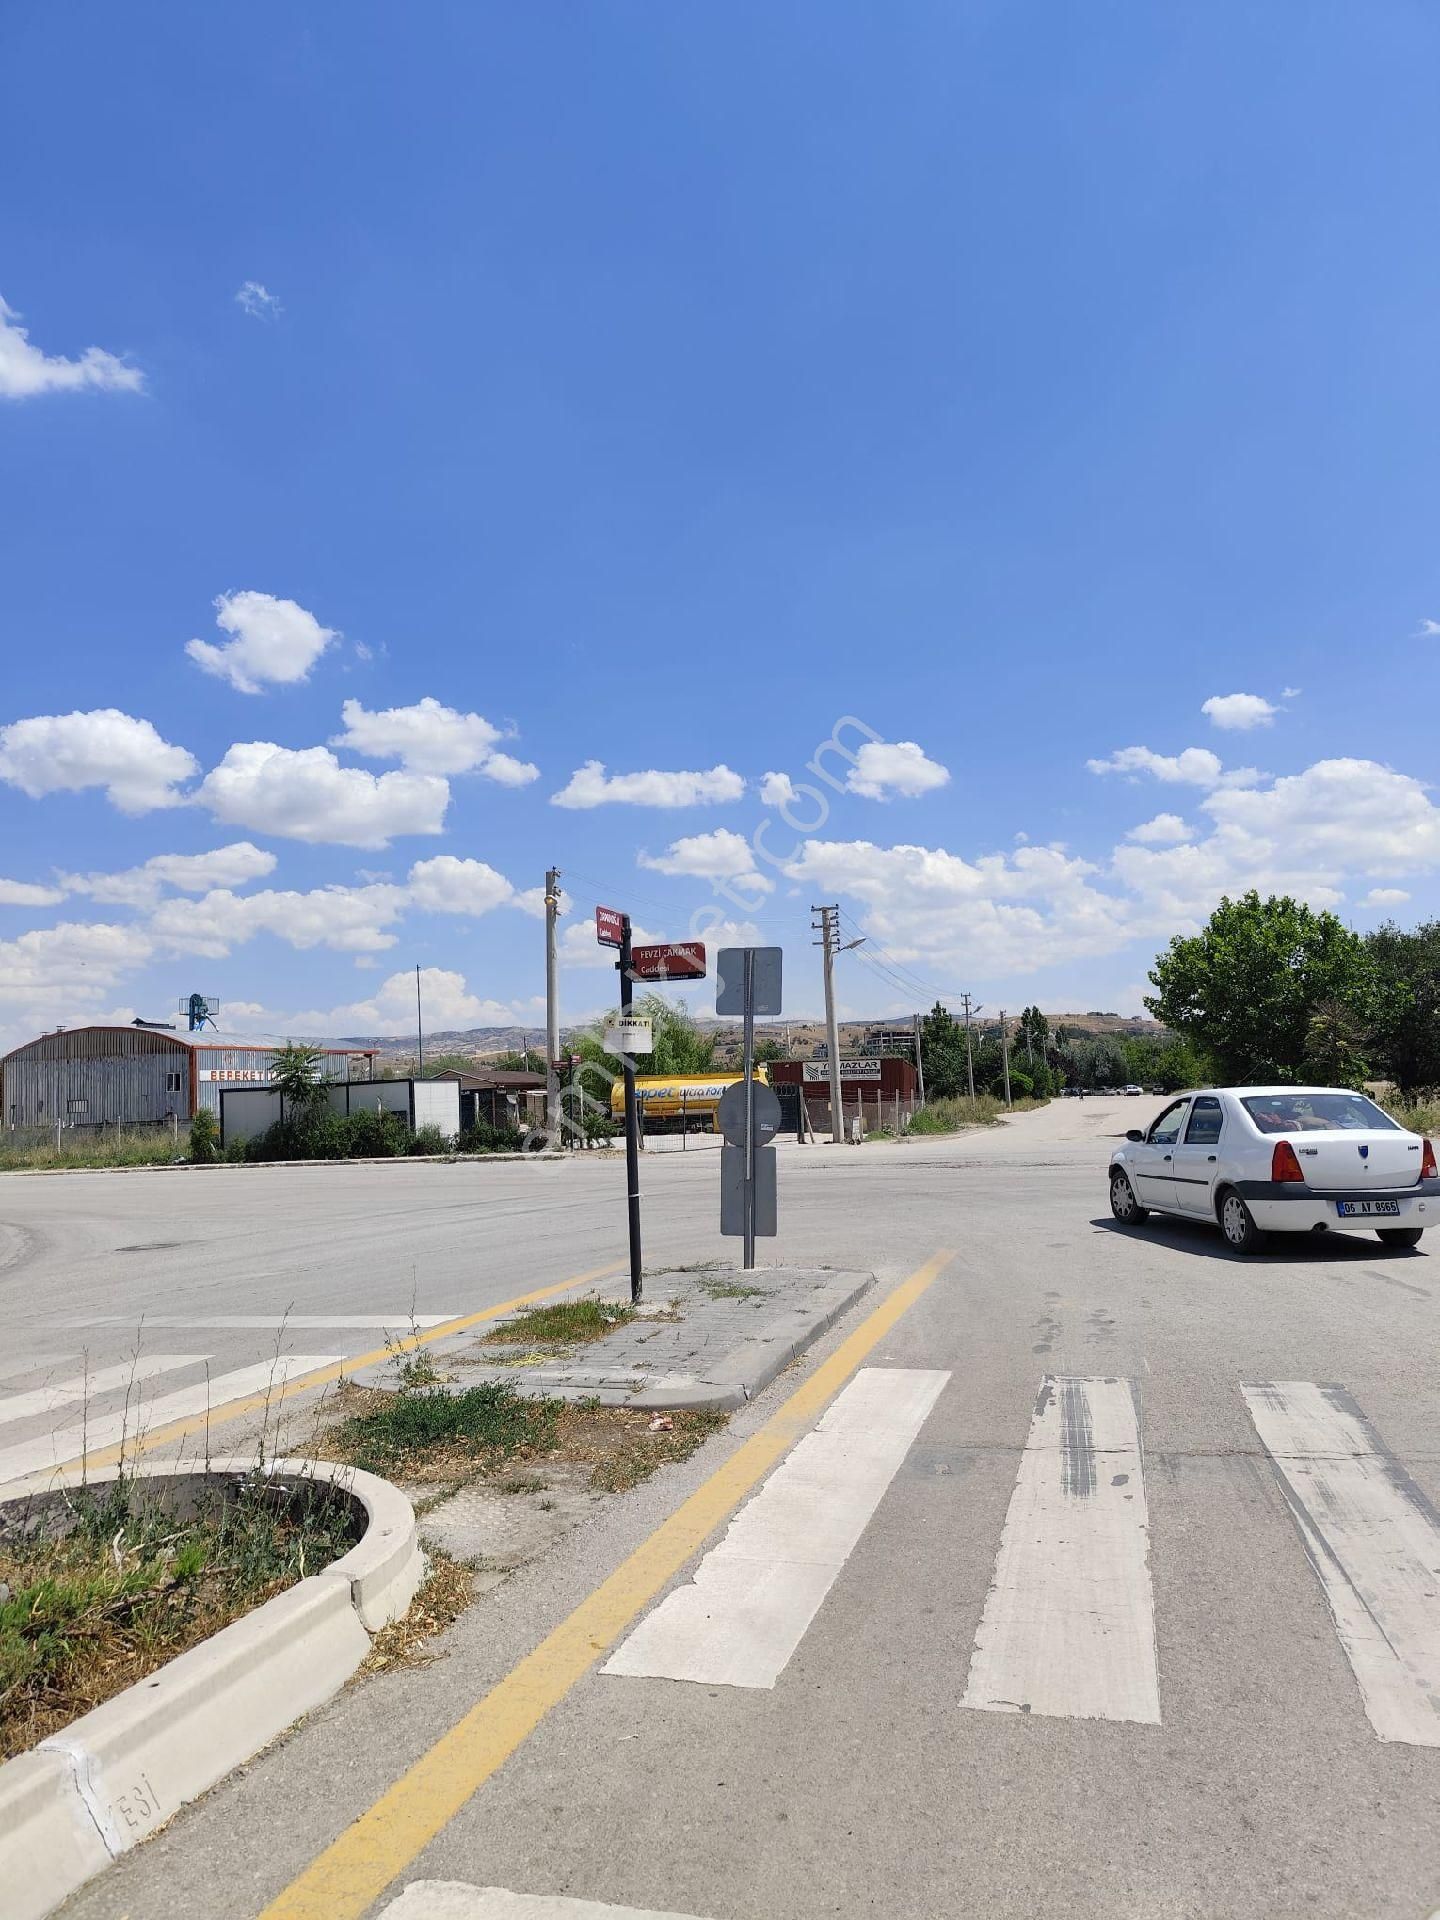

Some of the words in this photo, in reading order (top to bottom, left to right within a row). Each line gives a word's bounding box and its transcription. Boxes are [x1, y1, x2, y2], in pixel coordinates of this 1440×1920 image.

[641, 948, 661, 959] FEVZİ
[641, 964, 670, 973] Caddesi
[211, 1070, 263, 1081] BEREKET
[1345, 1203, 1355, 1213] 06
